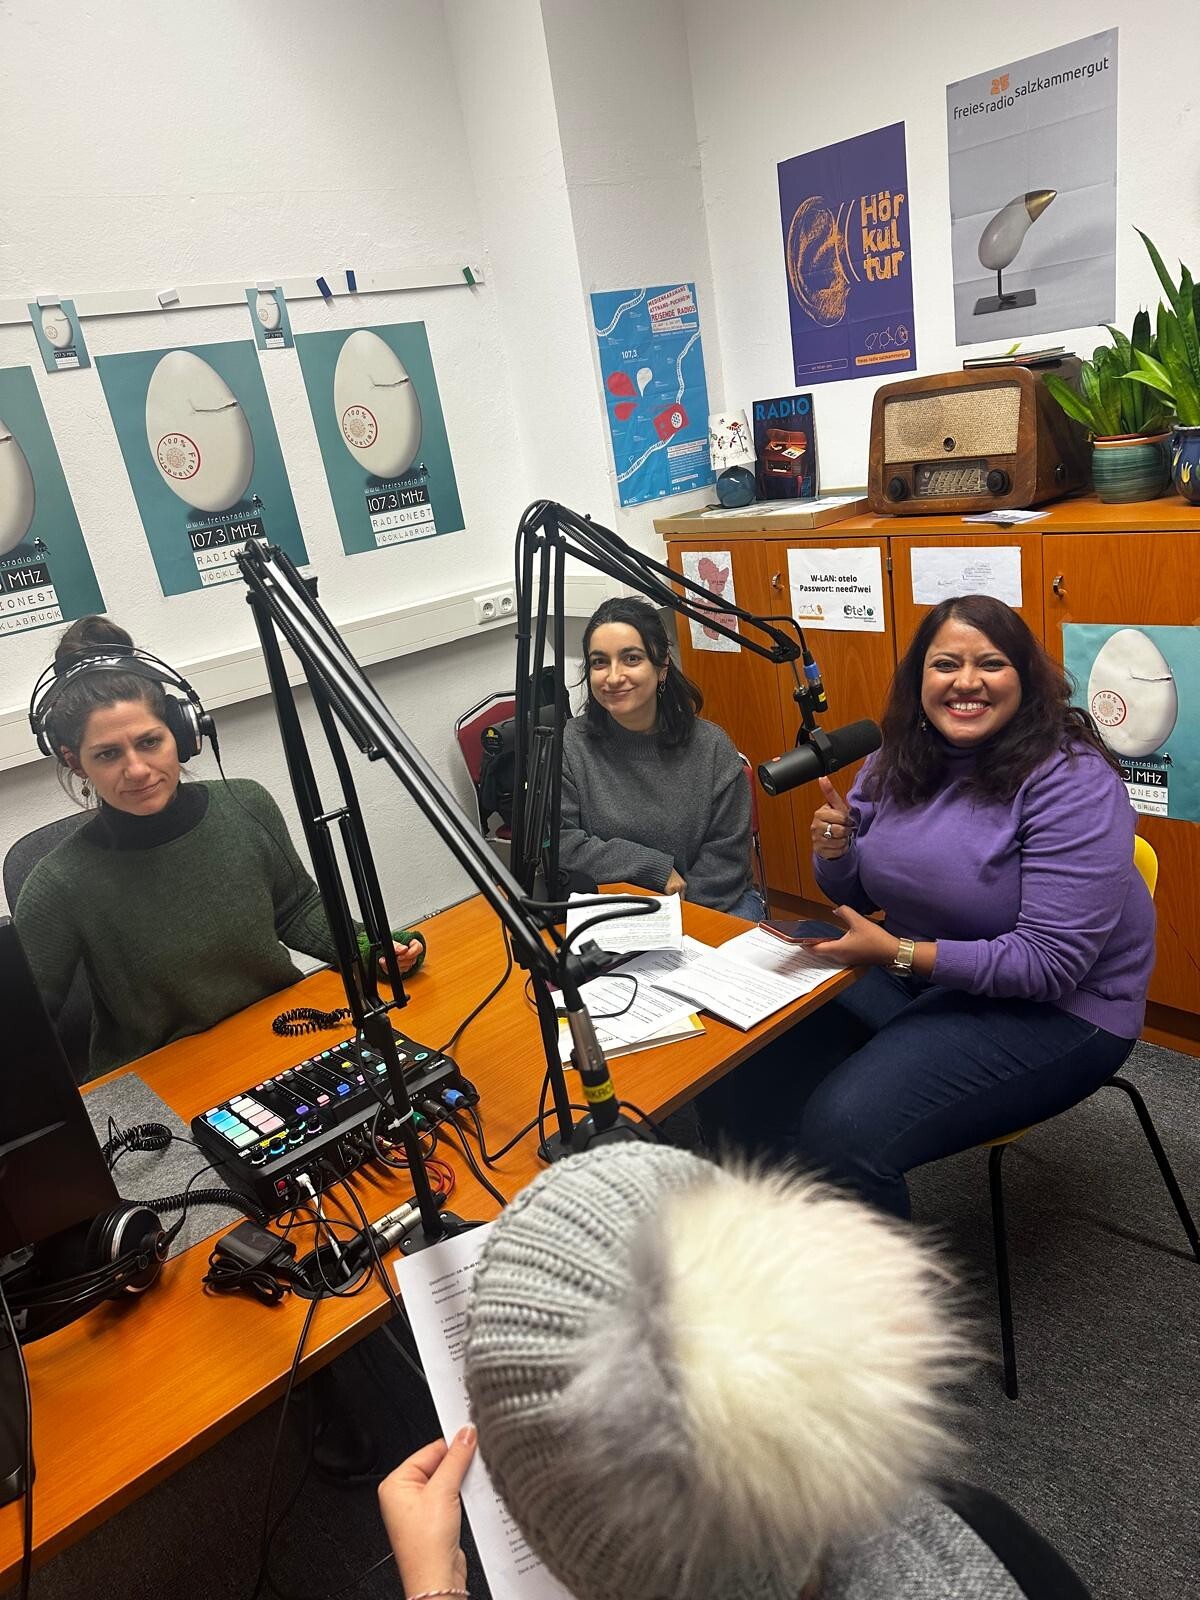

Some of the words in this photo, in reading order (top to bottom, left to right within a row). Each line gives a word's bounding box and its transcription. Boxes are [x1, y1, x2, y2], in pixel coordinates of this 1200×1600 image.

[1015, 57, 1109, 98] salzkammergut
[861, 190, 904, 227] Hör
[864, 250, 904, 282] tur
[756, 398, 810, 421] RADIO
[400, 489, 426, 505] MHz
[372, 508, 432, 528] RADIONEST
[190, 528, 227, 549] 107,3
[230, 522, 261, 541] MHz
[7, 569, 45, 589] MHz
[810, 574, 837, 582] W-LAN:
[838, 574, 858, 583] otelo
[799, 584, 835, 593] Passwort:
[835, 584, 872, 594] need7wei
[1136, 770, 1162, 785] MHz
